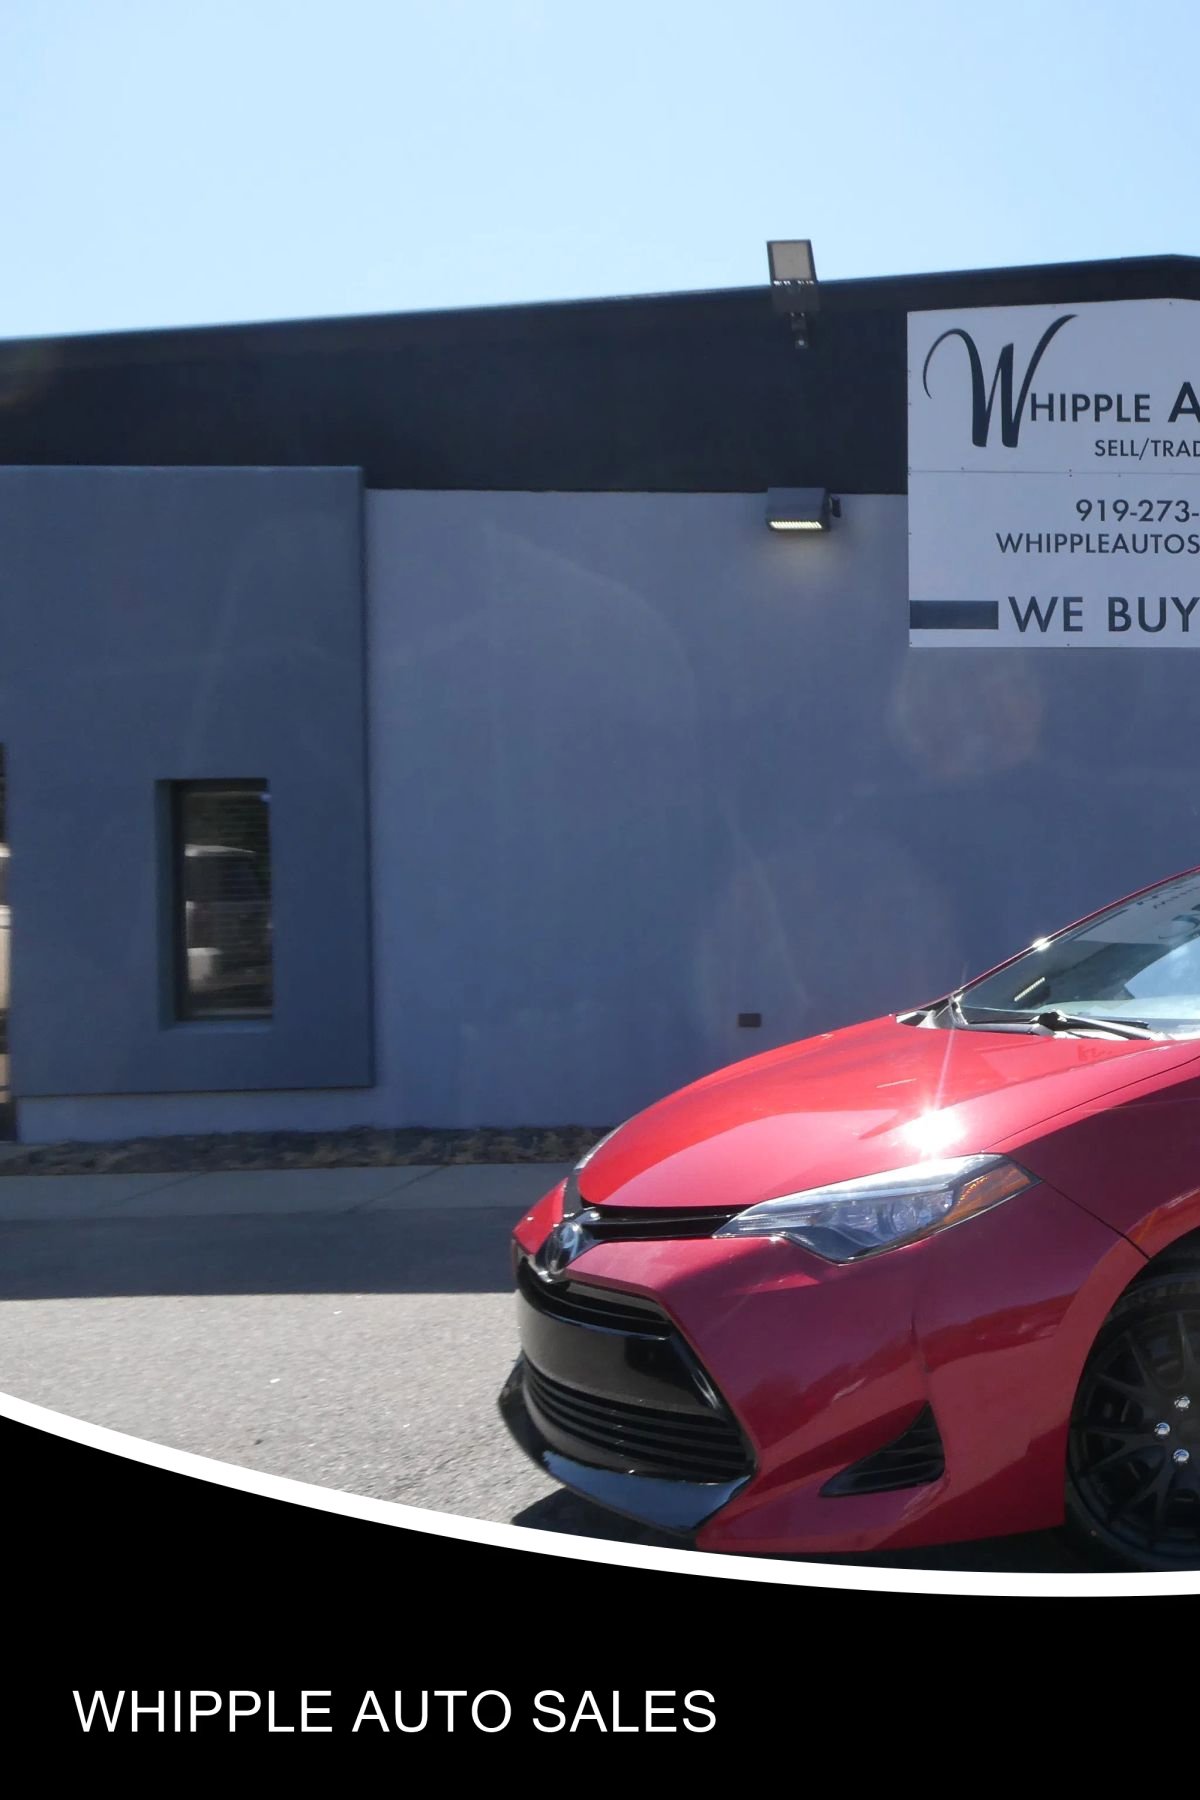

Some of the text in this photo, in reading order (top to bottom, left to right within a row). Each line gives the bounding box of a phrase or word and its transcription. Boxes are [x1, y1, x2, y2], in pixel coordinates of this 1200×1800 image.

[923, 314, 1151, 448] WHIPPLE
[1008, 596, 1083, 632] WE
[1107, 596, 1200, 632] BUY
